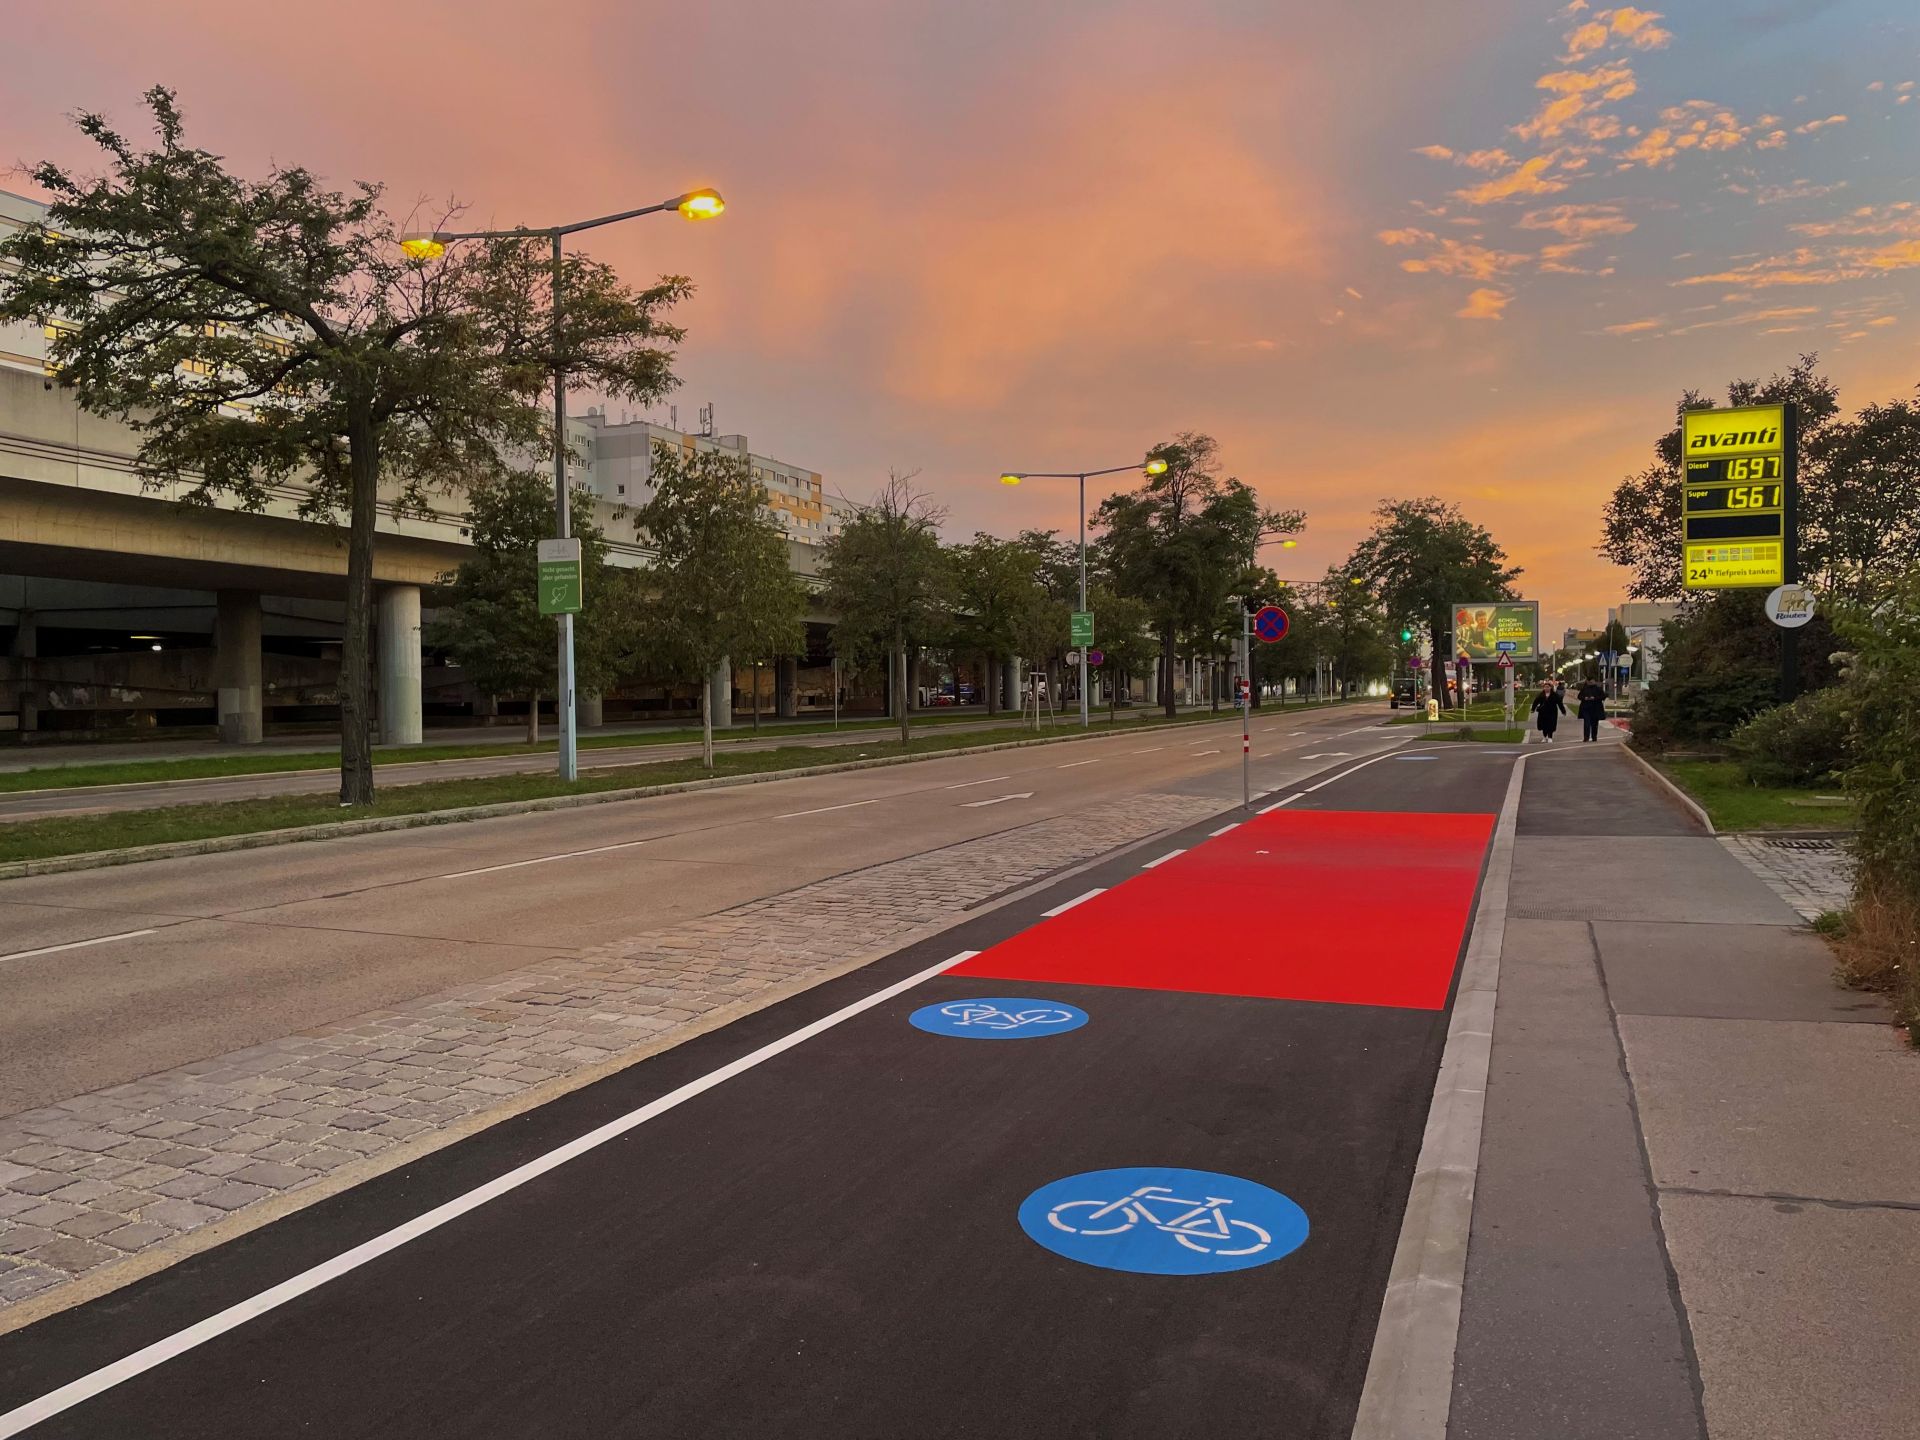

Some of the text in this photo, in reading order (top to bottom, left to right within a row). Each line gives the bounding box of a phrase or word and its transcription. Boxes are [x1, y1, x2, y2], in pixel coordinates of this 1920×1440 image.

[1690, 427, 1778, 448] avanti
[1688, 461, 1709, 470] Diesel
[1688, 490, 1709, 499] Super
[1715, 569, 1747, 578] Tiefpreis
